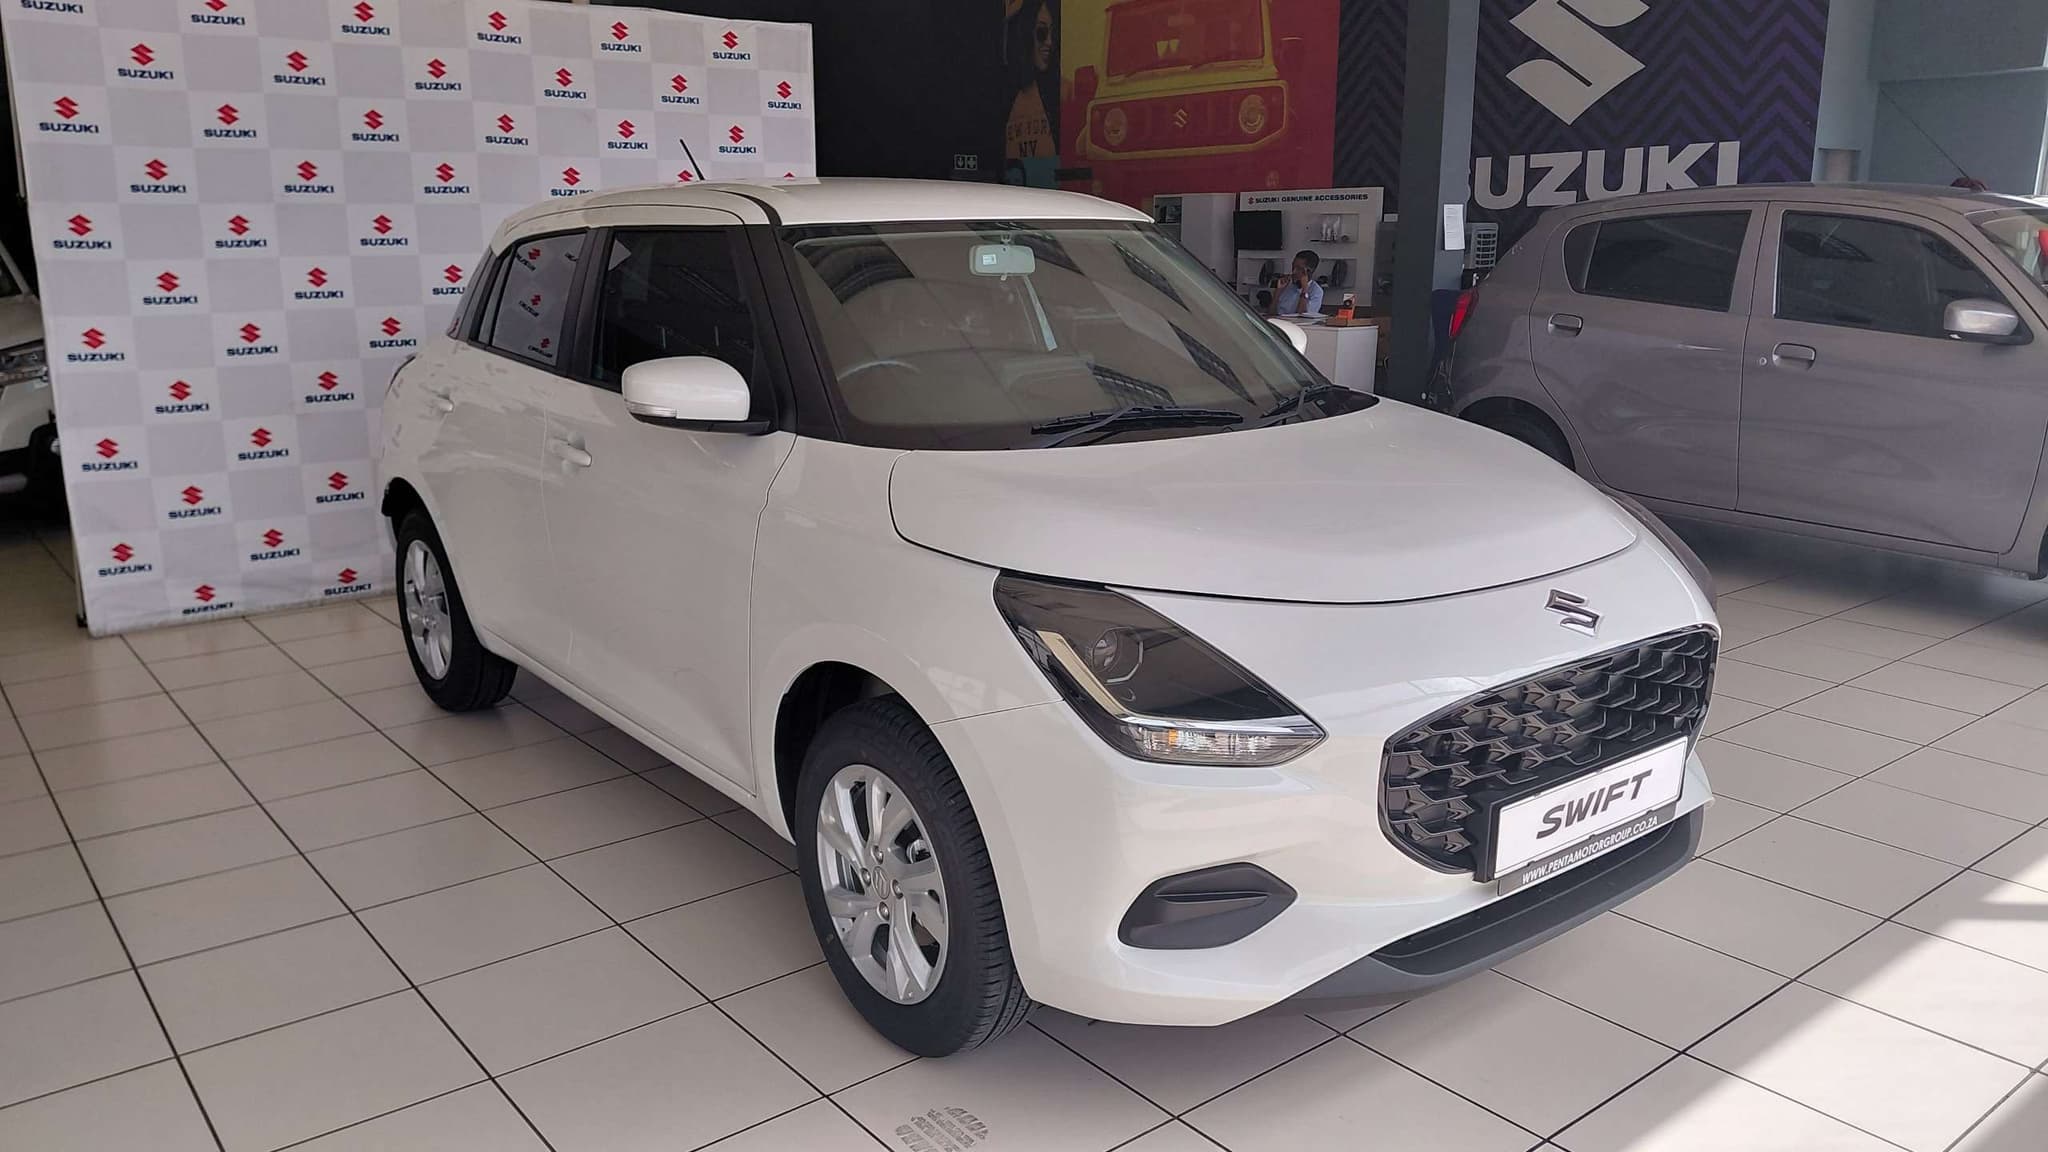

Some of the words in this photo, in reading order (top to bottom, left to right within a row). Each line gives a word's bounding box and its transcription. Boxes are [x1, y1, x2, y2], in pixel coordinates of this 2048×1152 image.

[20, 0, 84, 14] SUZUKI
[190, 14, 246, 26] SUZUKI
[341, 24, 391, 36] SUZUKI
[476, 31, 522, 45] SUZUKI
[600, 42, 642, 53] SUZUKI
[712, 51, 751, 61] SUZUKI
[117, 67, 174, 80] SUZUKI
[273, 74, 326, 86] SUZUKI
[414, 81, 462, 91] SUZUKI
[543, 88, 587, 100] SUZUKI
[660, 95, 700, 105] SUZUKI
[767, 100, 802, 110] SUZUKI
[38, 121, 100, 134] SUZUKI
[203, 128, 257, 139] SUZUKI
[351, 132, 400, 142] SUZUKI
[484, 135, 529, 146] SUZUKI
[607, 141, 649, 150] SUZUKI
[718, 145, 757, 154] SUZUKI
[1466, 140, 1741, 210] UZUKI
[129, 184, 187, 194] SUZUKI
[283, 184, 335, 194] SUZUKI
[423, 185, 470, 195] SUZUKI
[1255, 196, 1280, 205] SUZUKI
[1281, 195, 1313, 203] GENUINE
[1314, 193, 1369, 202] ACCESSORIES
[52, 239, 112, 250] SUZUKI
[215, 238, 268, 249] SUZUKI
[359, 237, 409, 247] SUZUKI
[294, 290, 344, 300] SUZUKI
[432, 286, 466, 296] SUZU
[142, 295, 199, 306] SUZUKI
[368, 338, 417, 349] SUZUKI
[226, 345, 279, 357] SUZUKI
[66, 352, 125, 363] SUZUKI
[304, 392, 355, 404] SUZUKI
[154, 402, 210, 415] SUZUKI
[237, 448, 290, 461] SUZUKI
[81, 460, 139, 473] SUZUKI
[315, 491, 365, 504] SUZUKI
[167, 506, 222, 520] SUZUKI
[249, 547, 301, 562] SUZUKI
[97, 563, 153, 578] SUZUKI
[323, 582, 373, 598] SUZUKI
[181, 601, 235, 616] SUZUKI
[1536, 768, 1652, 840] SWIFT
[1521, 815, 1658, 885] WWW.PENTAMOTORGROUP.CO.ZA
